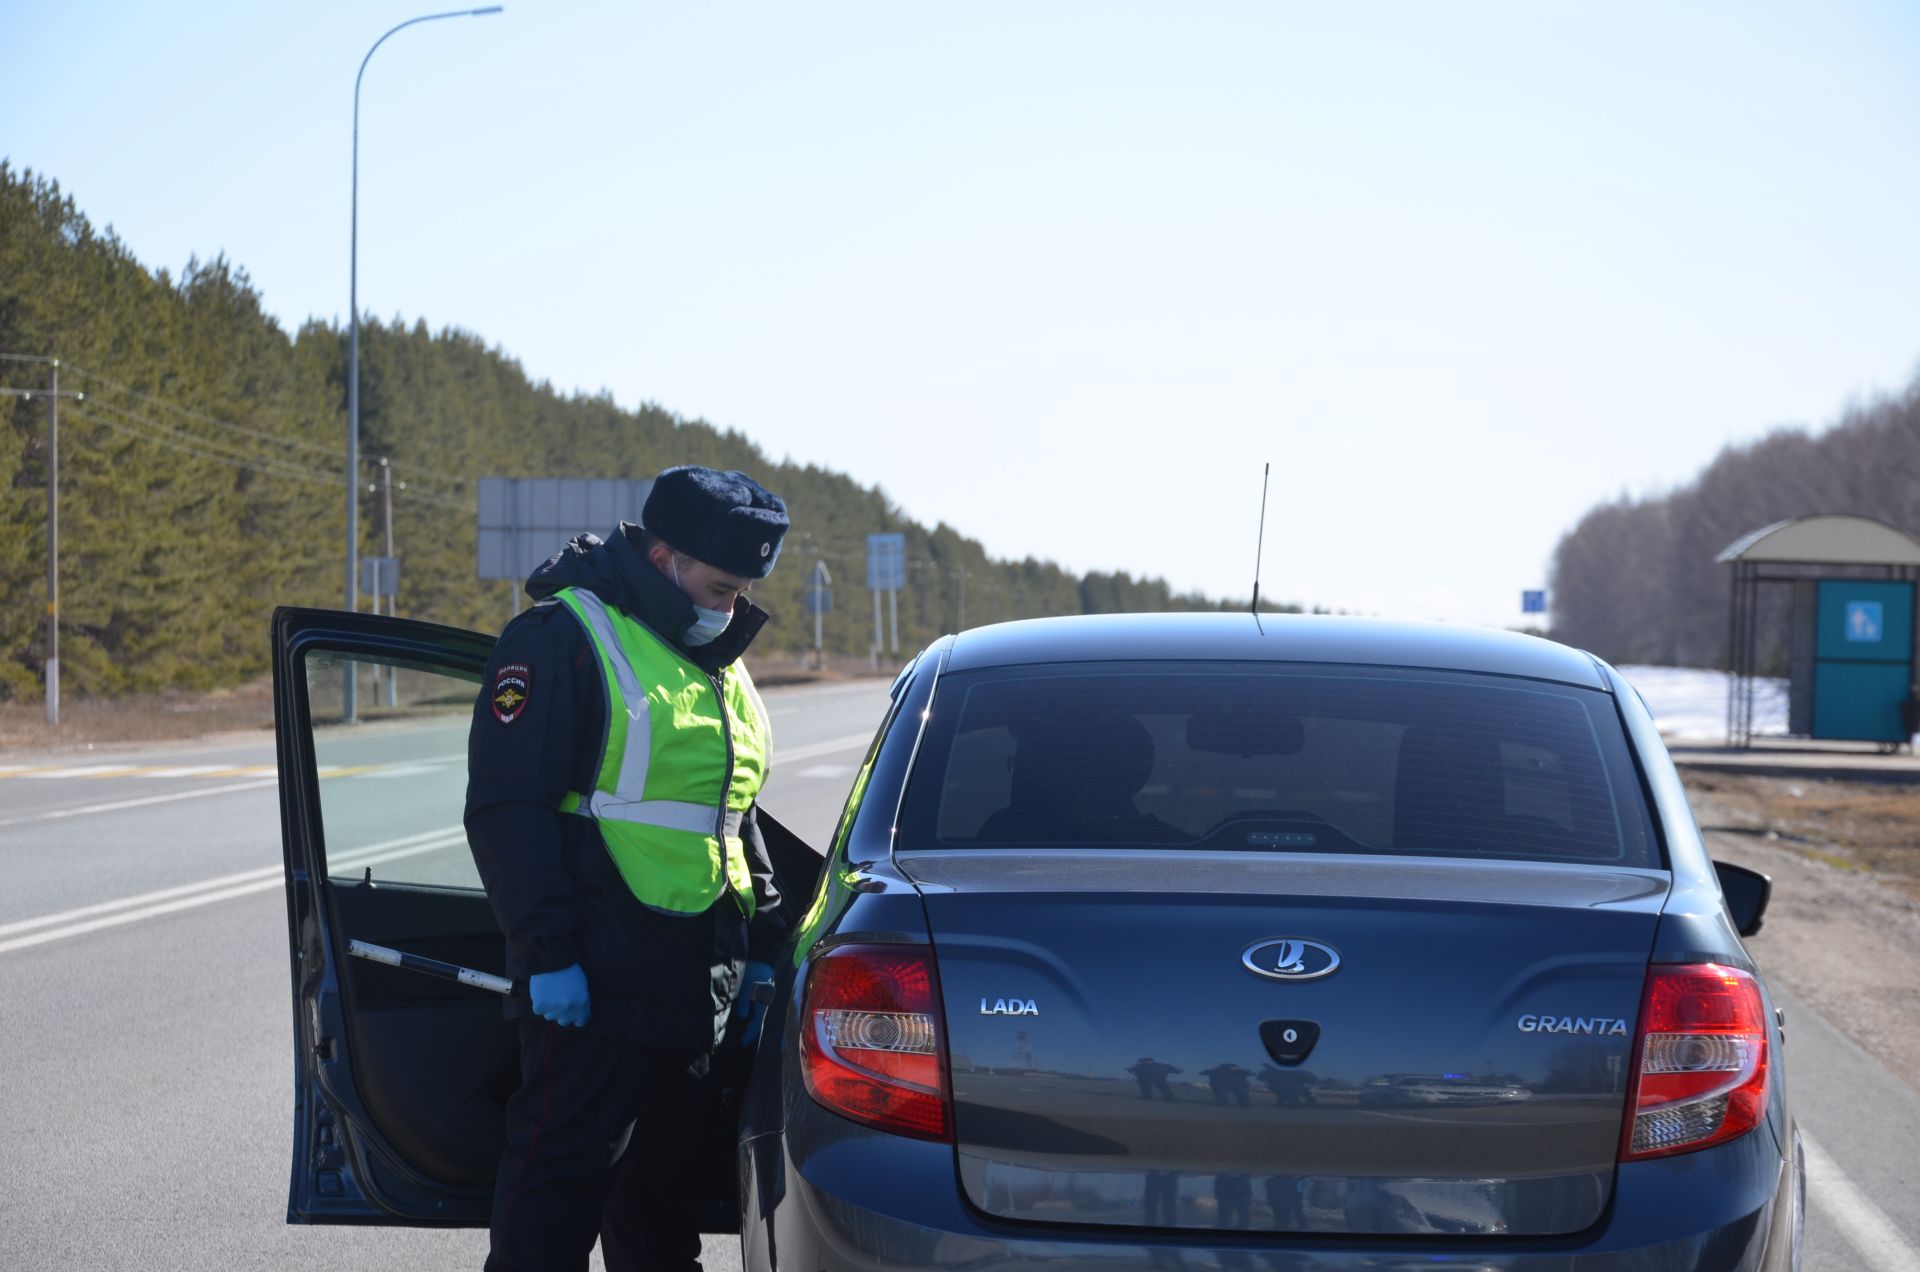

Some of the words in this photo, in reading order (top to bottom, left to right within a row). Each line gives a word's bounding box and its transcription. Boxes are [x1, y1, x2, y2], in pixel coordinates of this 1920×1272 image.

[497, 677, 525, 690] РОССИЯ
[980, 998, 1039, 1016] LADA
[1517, 1014, 1628, 1036] GRANTA
